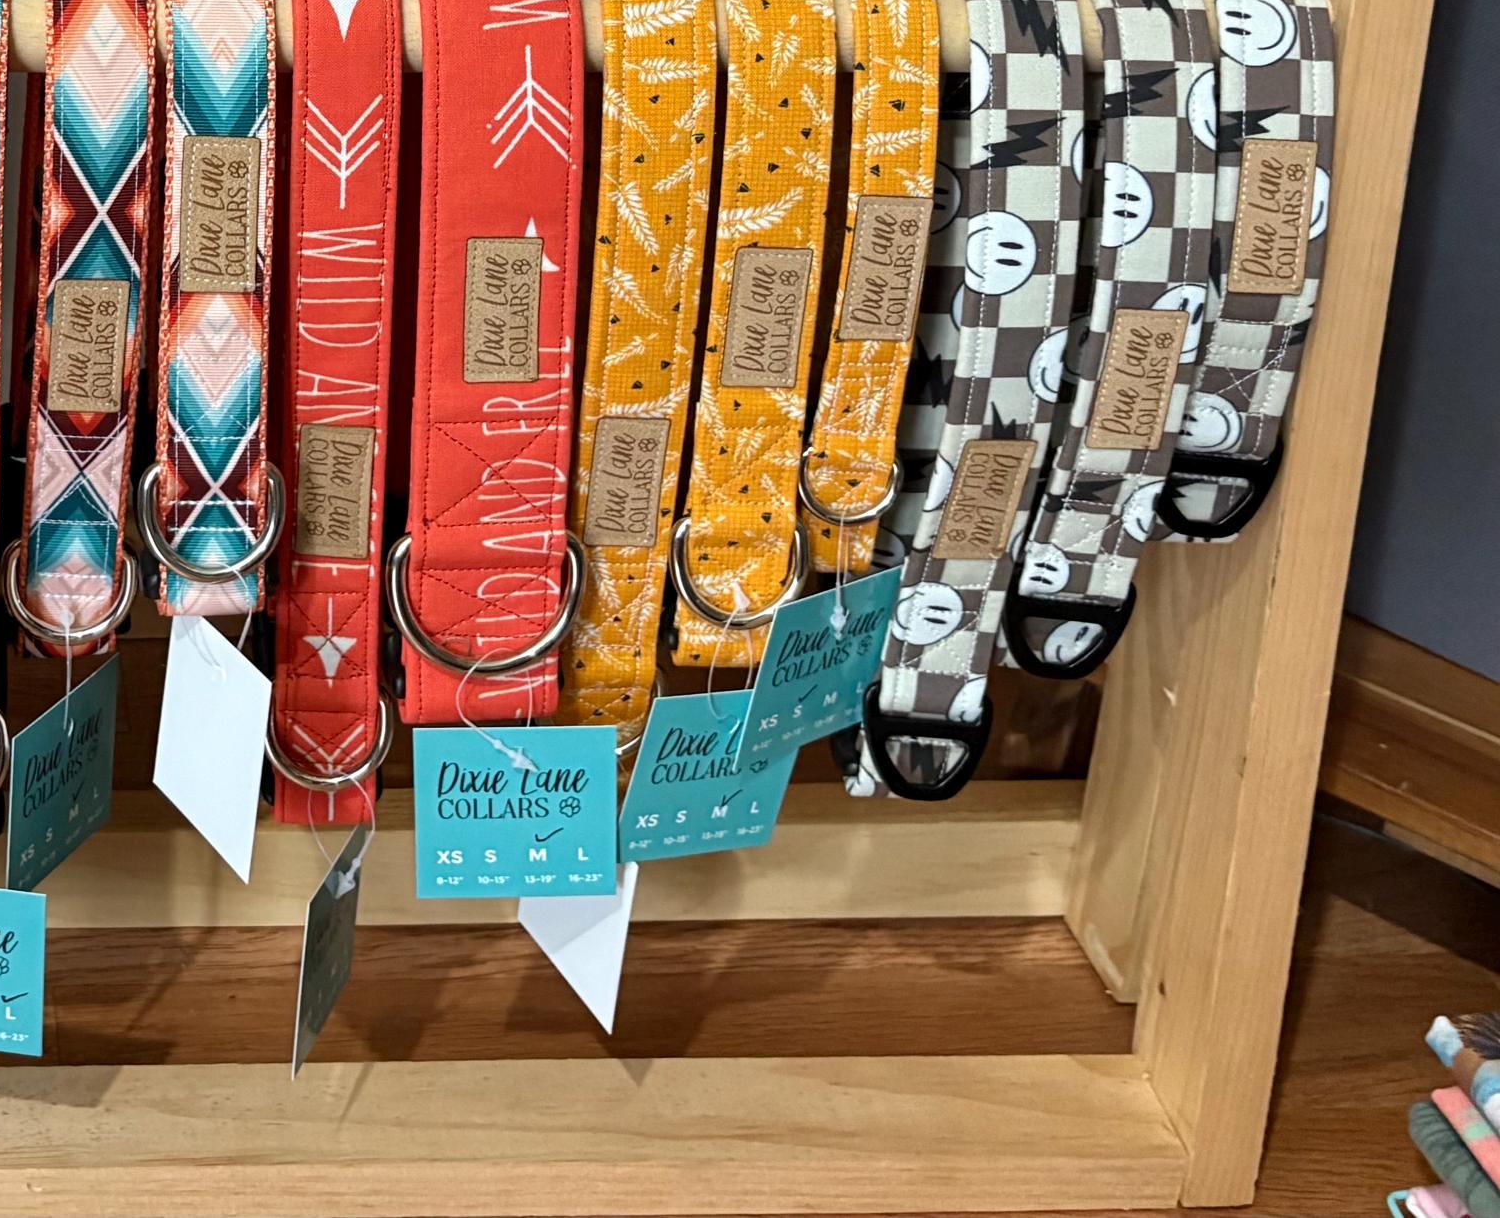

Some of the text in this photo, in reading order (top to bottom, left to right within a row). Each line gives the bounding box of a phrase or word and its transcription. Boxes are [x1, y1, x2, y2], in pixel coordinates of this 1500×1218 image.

[189, 154, 226, 279] Dixie Lane
[224, 184, 248, 278] COLLARS
[1238, 156, 1284, 278] Dixie Lane
[1275, 189, 1303, 279] COLLARS
[298, 222, 388, 348] WILD
[473, 253, 509, 367] Dixie Lane
[850, 212, 897, 326] Dixie Lane
[884, 244, 916, 327] COLLARS
[56, 294, 96, 399] Dixie Lane
[508, 282, 530, 367] COLLARS
[733, 263, 777, 372] Dixie Lane
[767, 294, 796, 374] COLLARS
[91, 321, 116, 399] COLLARS
[1100, 325, 1153, 436] Dixie Lane
[1134, 356, 1169, 437] COLLARS
[306, 438, 330, 517] COLLARS
[329, 438, 364, 488] Dixie
[595, 432, 636, 533] Dixie Lane
[627, 458, 655, 533] COLLARS
[953, 452, 990, 525] COLLARS
[970, 454, 1022, 546] Dixie Lane
[326, 490, 360, 543] Lane
[477, 459, 567, 556] AND
[437, 761, 590, 798] Dixie Lane
[656, 727, 719, 763] Dixie
[437, 797, 550, 820] COLLARS
[636, 801, 760, 829] XS S M L
[436, 847, 589, 864] XS S M L
[5, 1007, 16, 1020] L
